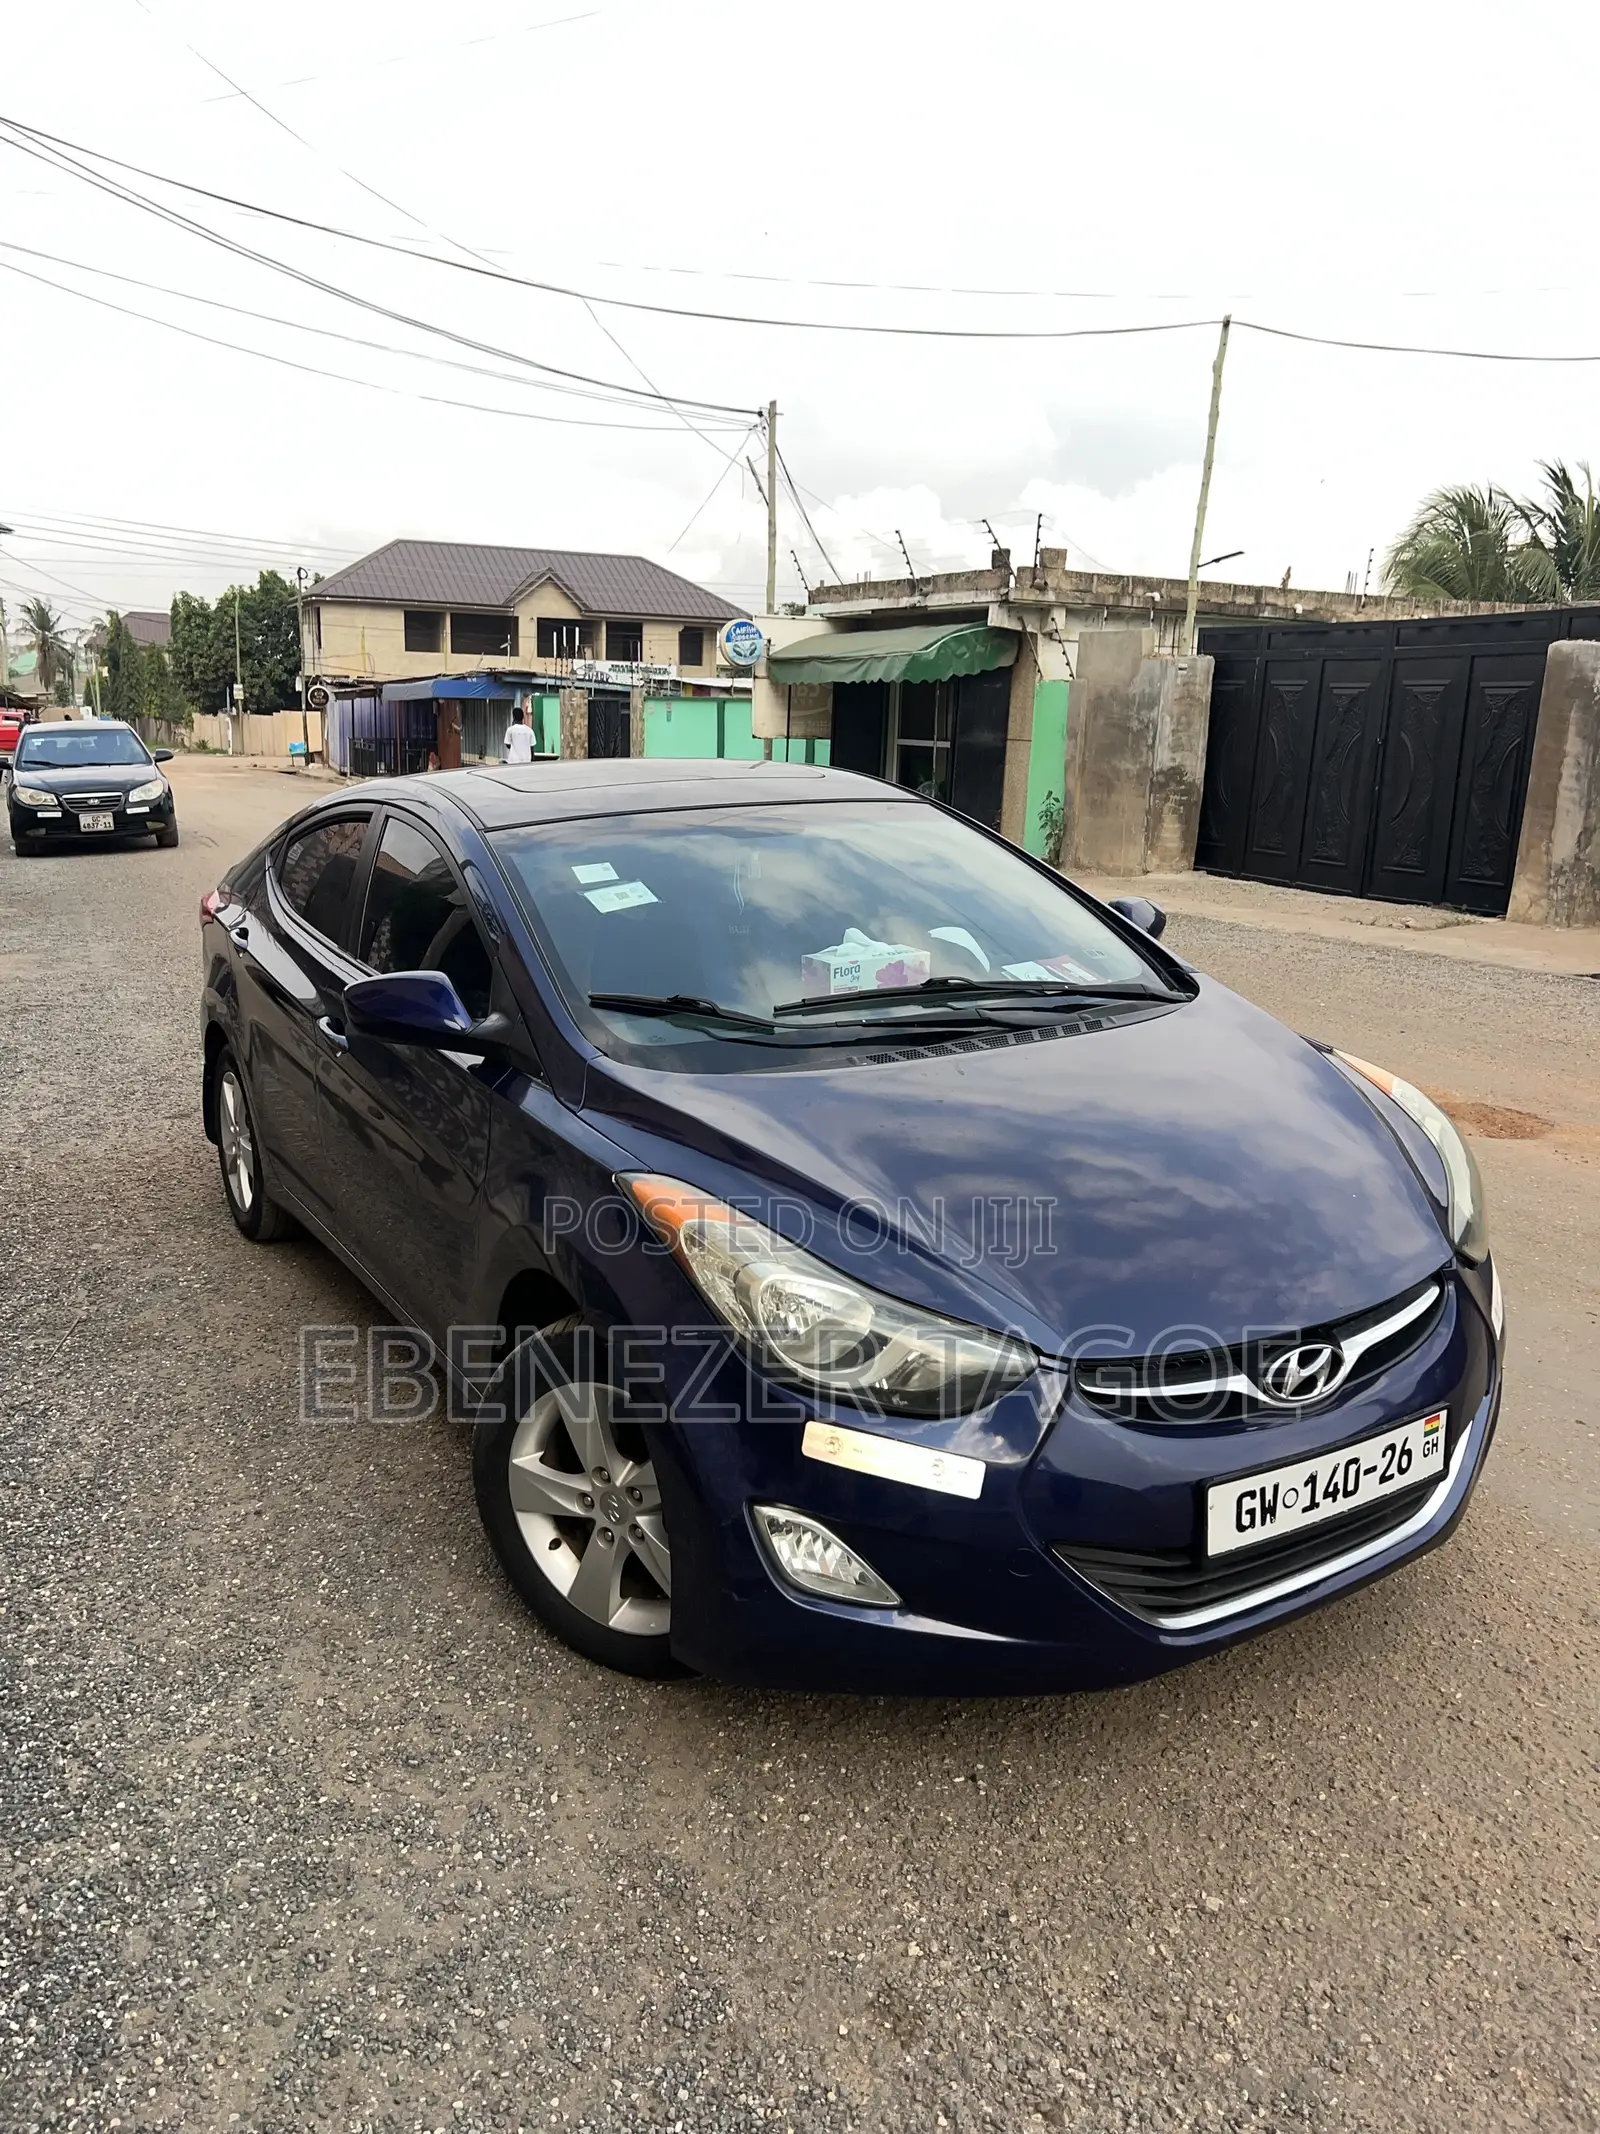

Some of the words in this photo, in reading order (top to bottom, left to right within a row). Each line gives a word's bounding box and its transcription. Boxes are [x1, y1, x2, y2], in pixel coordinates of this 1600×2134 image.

[833, 964, 861, 980] Flora
[1422, 1436, 1439, 1458] GH
[1235, 1481, 1279, 1533] GW
[1301, 1436, 1413, 1514] 140-26
